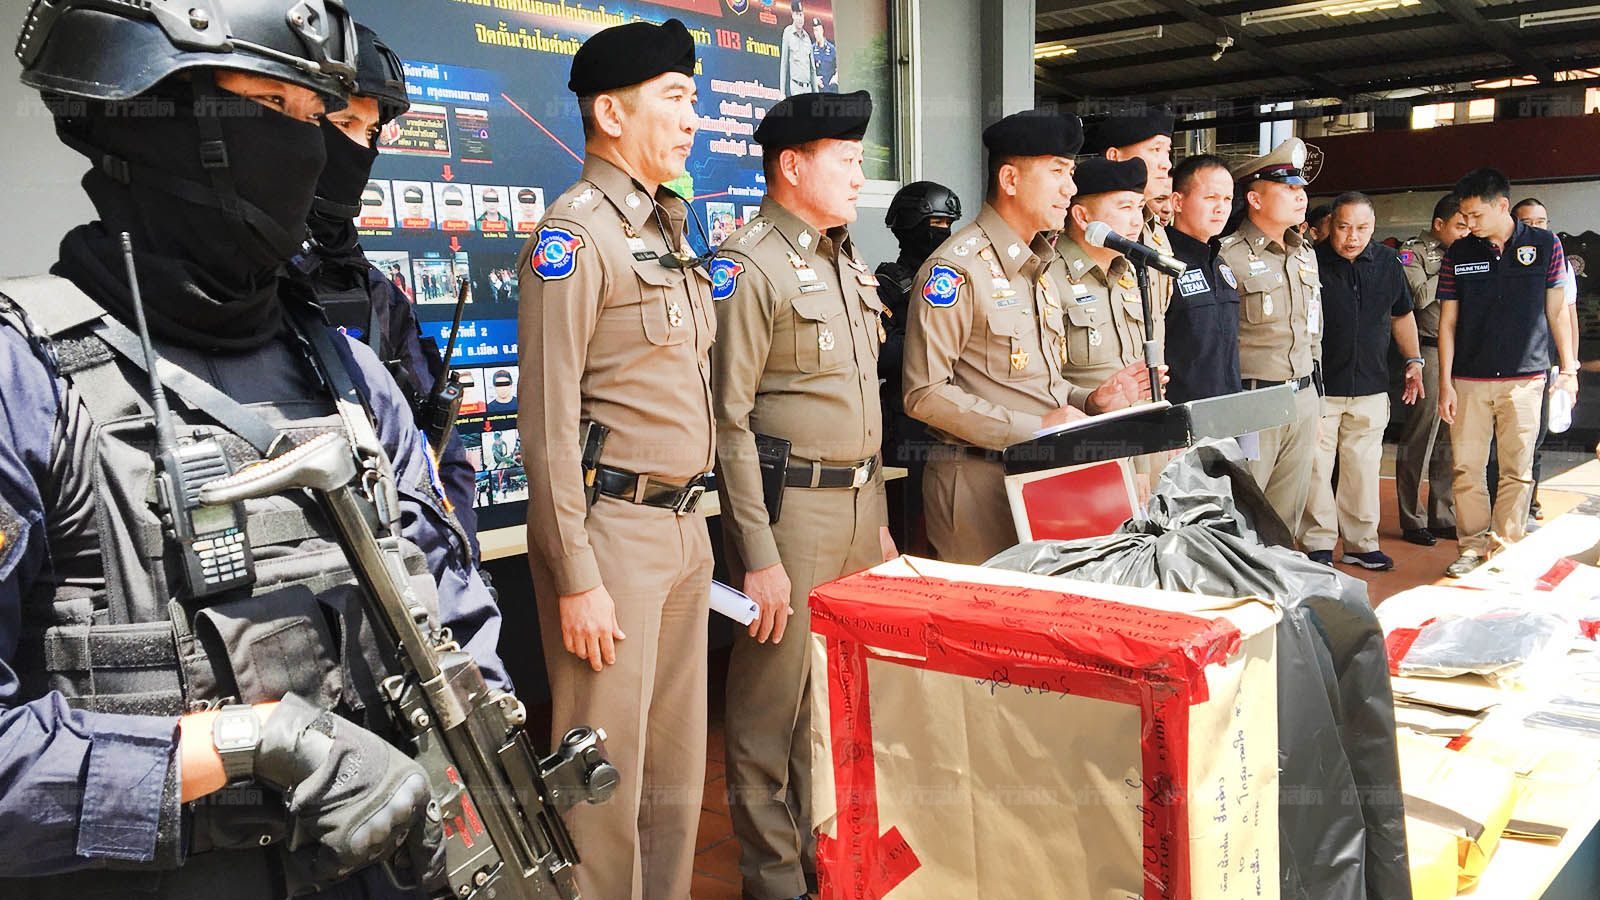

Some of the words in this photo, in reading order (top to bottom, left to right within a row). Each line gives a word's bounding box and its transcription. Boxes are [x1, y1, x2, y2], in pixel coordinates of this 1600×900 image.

[474, 20, 583, 55] ปิดกั้นเว็บไซต์พนั
[715, 28, 742, 50] 103
[1182, 281, 1205, 293] TEAM
[481, 327, 488, 338] 2
[854, 618, 911, 638] EVIDENCE
[970, 640, 1001, 655] TAPE
[1154, 703, 1167, 761] EVIDEN
